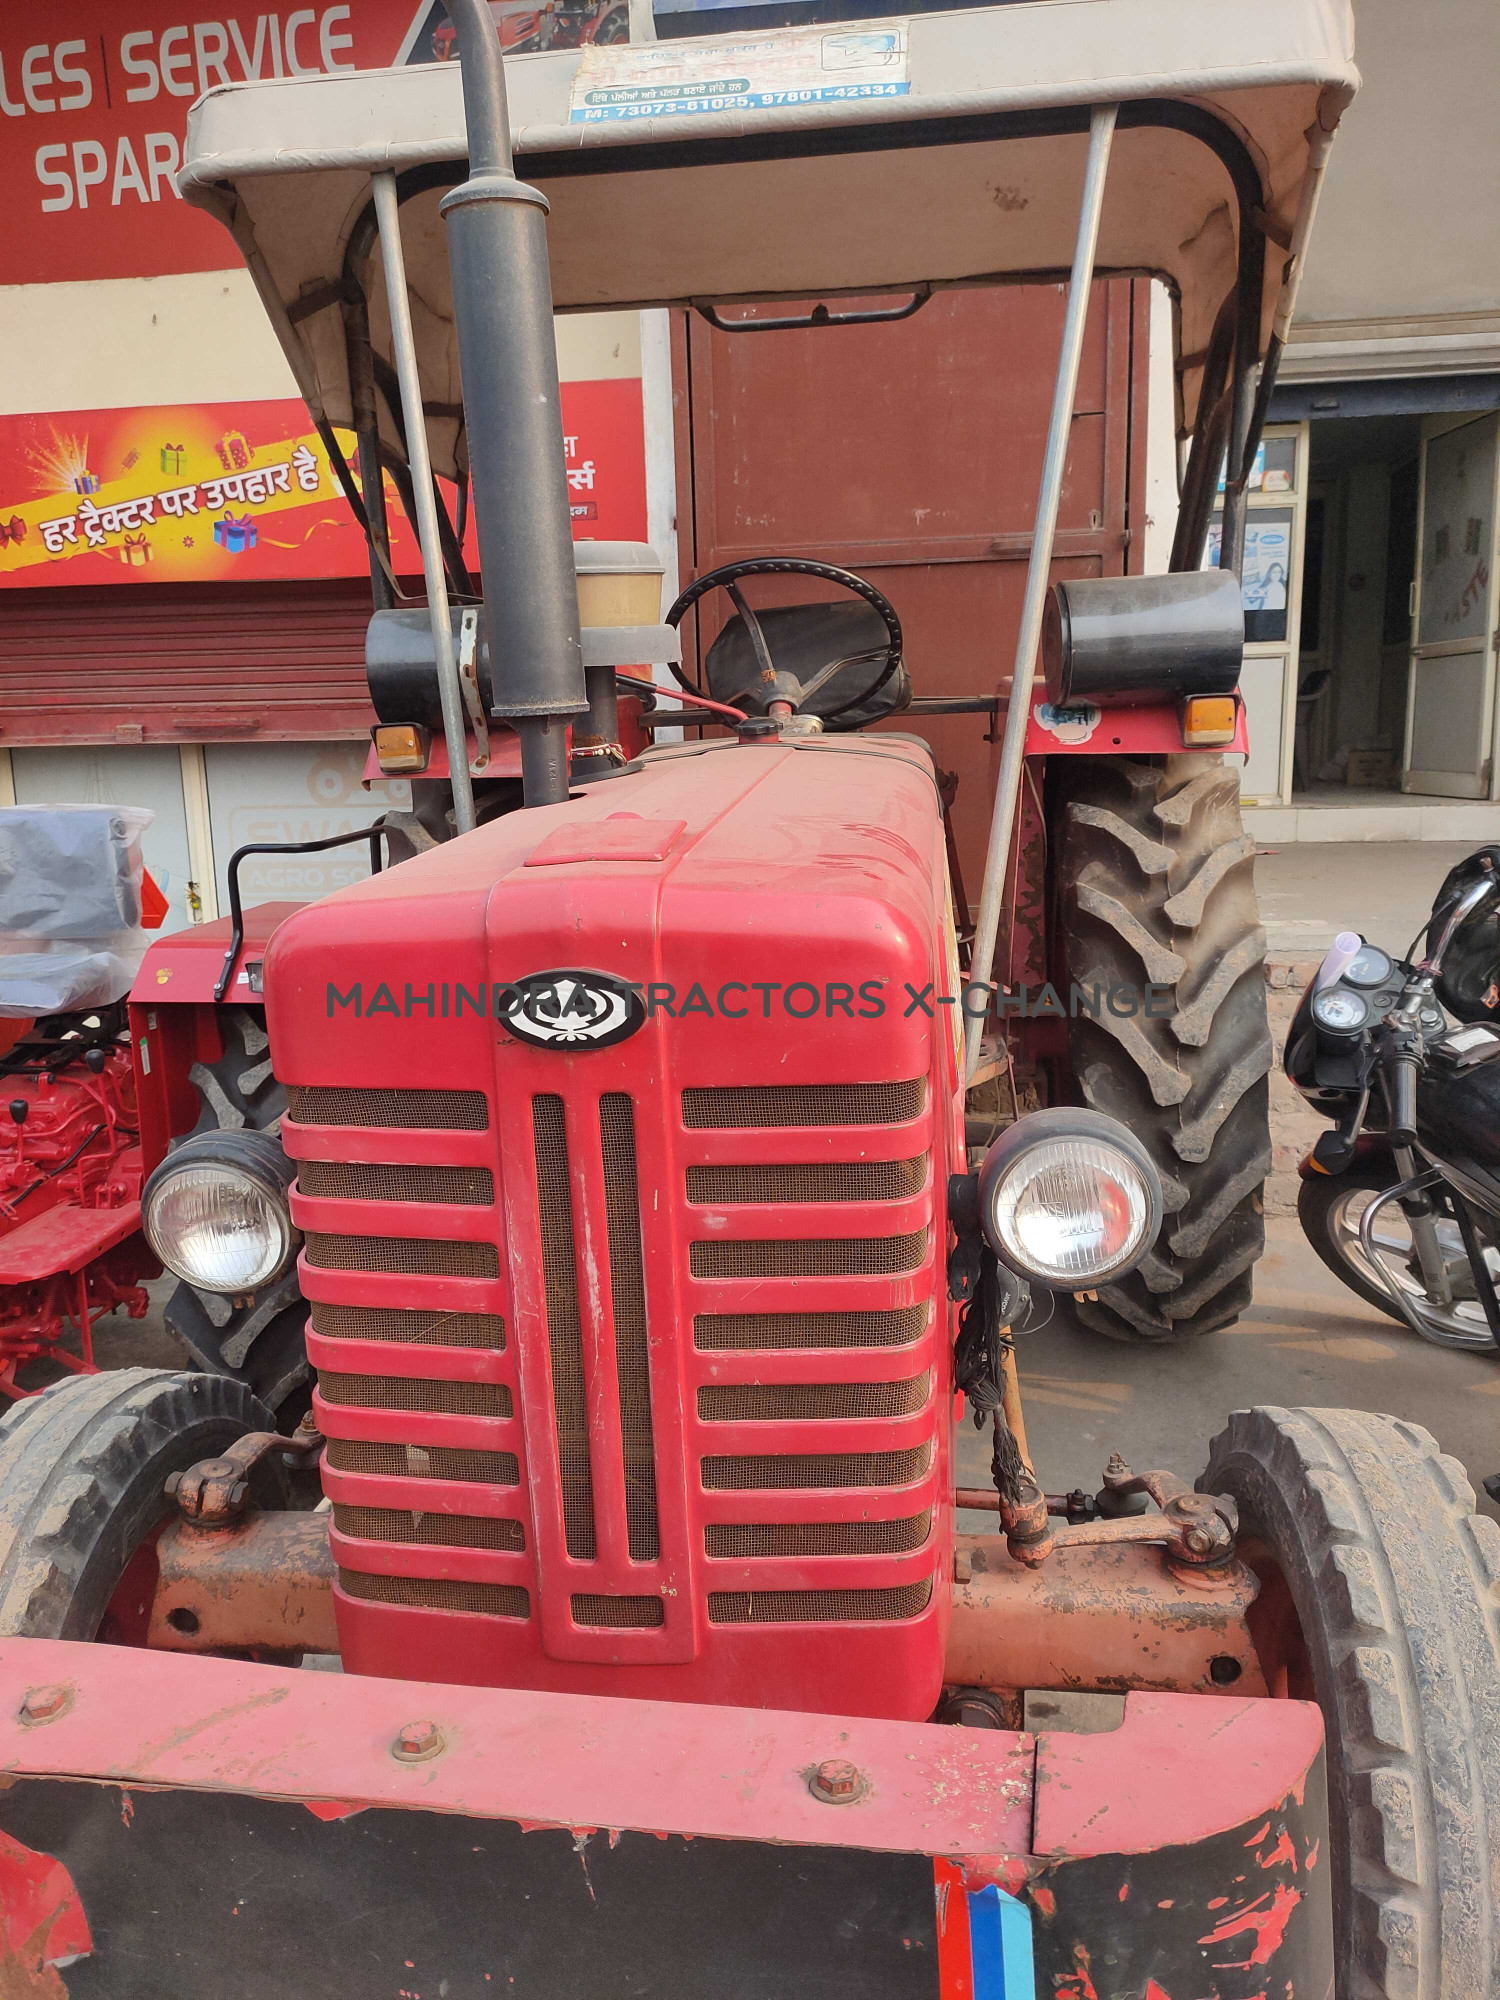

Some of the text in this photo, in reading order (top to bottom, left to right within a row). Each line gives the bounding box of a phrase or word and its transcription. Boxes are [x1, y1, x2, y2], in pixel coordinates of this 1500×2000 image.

[120, 5, 355, 103] SERVICE
[35, 132, 188, 213] SPAR
[39, 445, 319, 552] हर ट्रैक्टर पर उपहार है
[250, 867, 325, 888] AGRO
